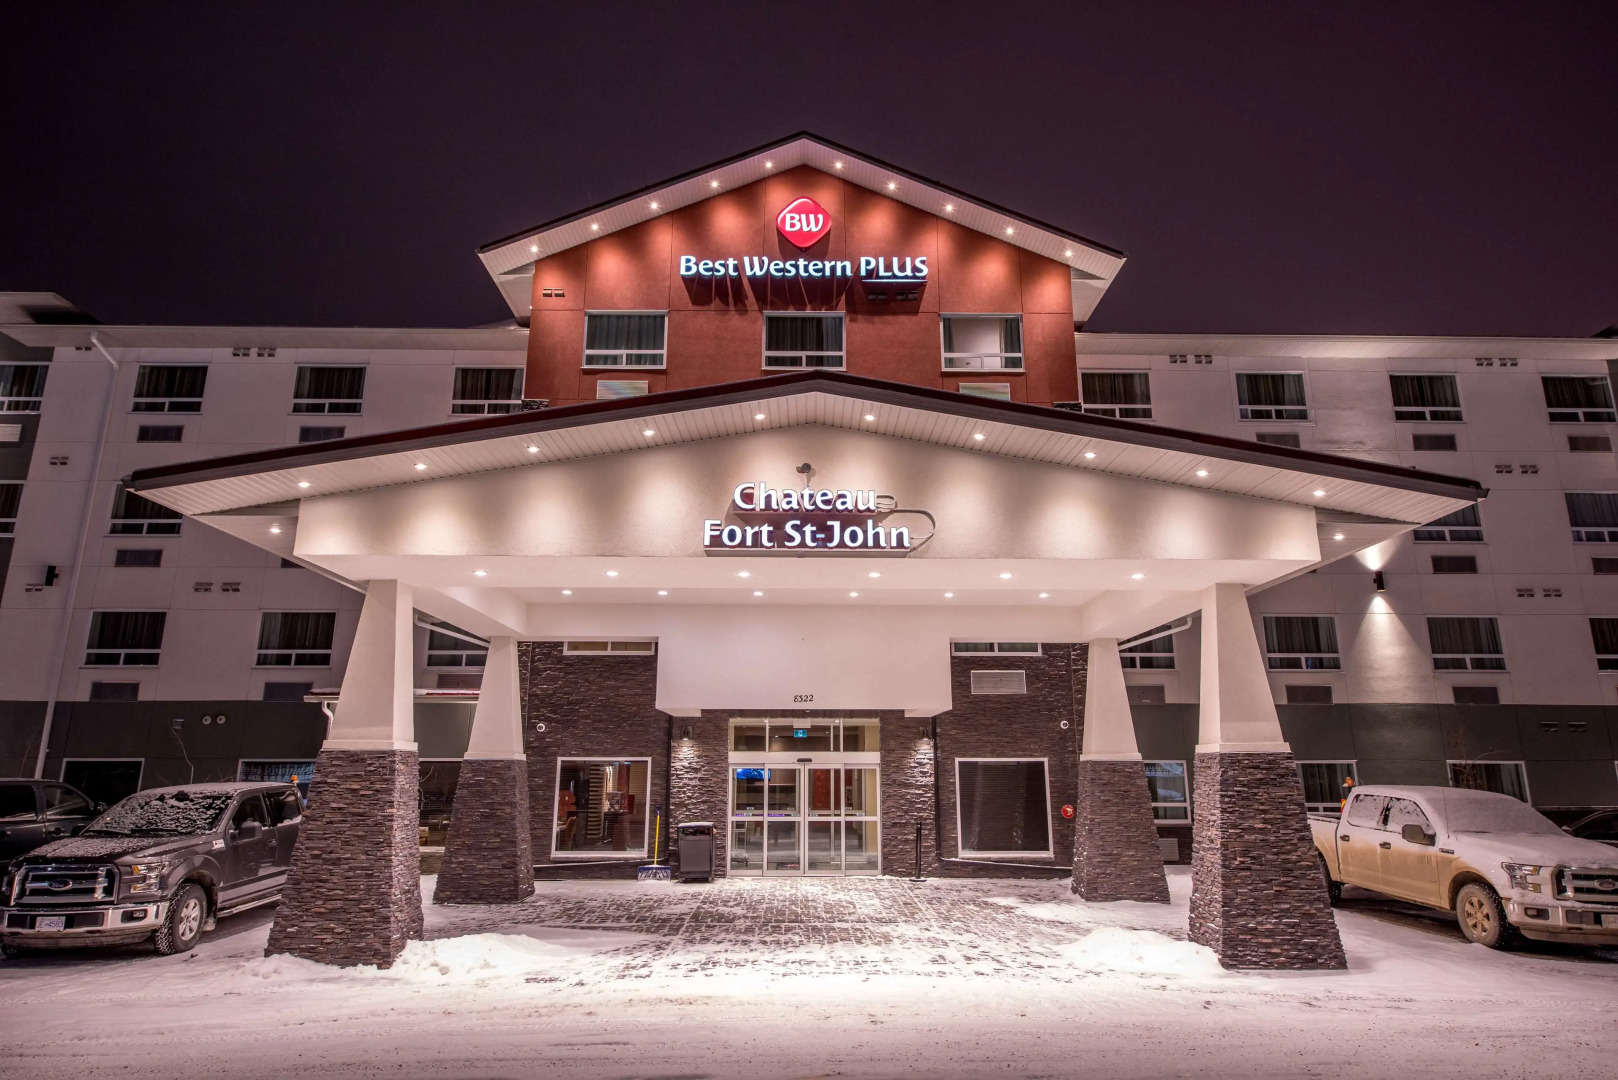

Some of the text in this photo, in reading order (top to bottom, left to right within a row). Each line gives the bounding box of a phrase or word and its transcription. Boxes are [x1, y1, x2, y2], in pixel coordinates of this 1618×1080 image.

[785, 213, 823, 232] BW
[680, 256, 929, 277] Best Western PLUS
[734, 481, 876, 512] Chateau
[703, 519, 911, 548] Fort St-John
[793, 694, 814, 703] 8322
